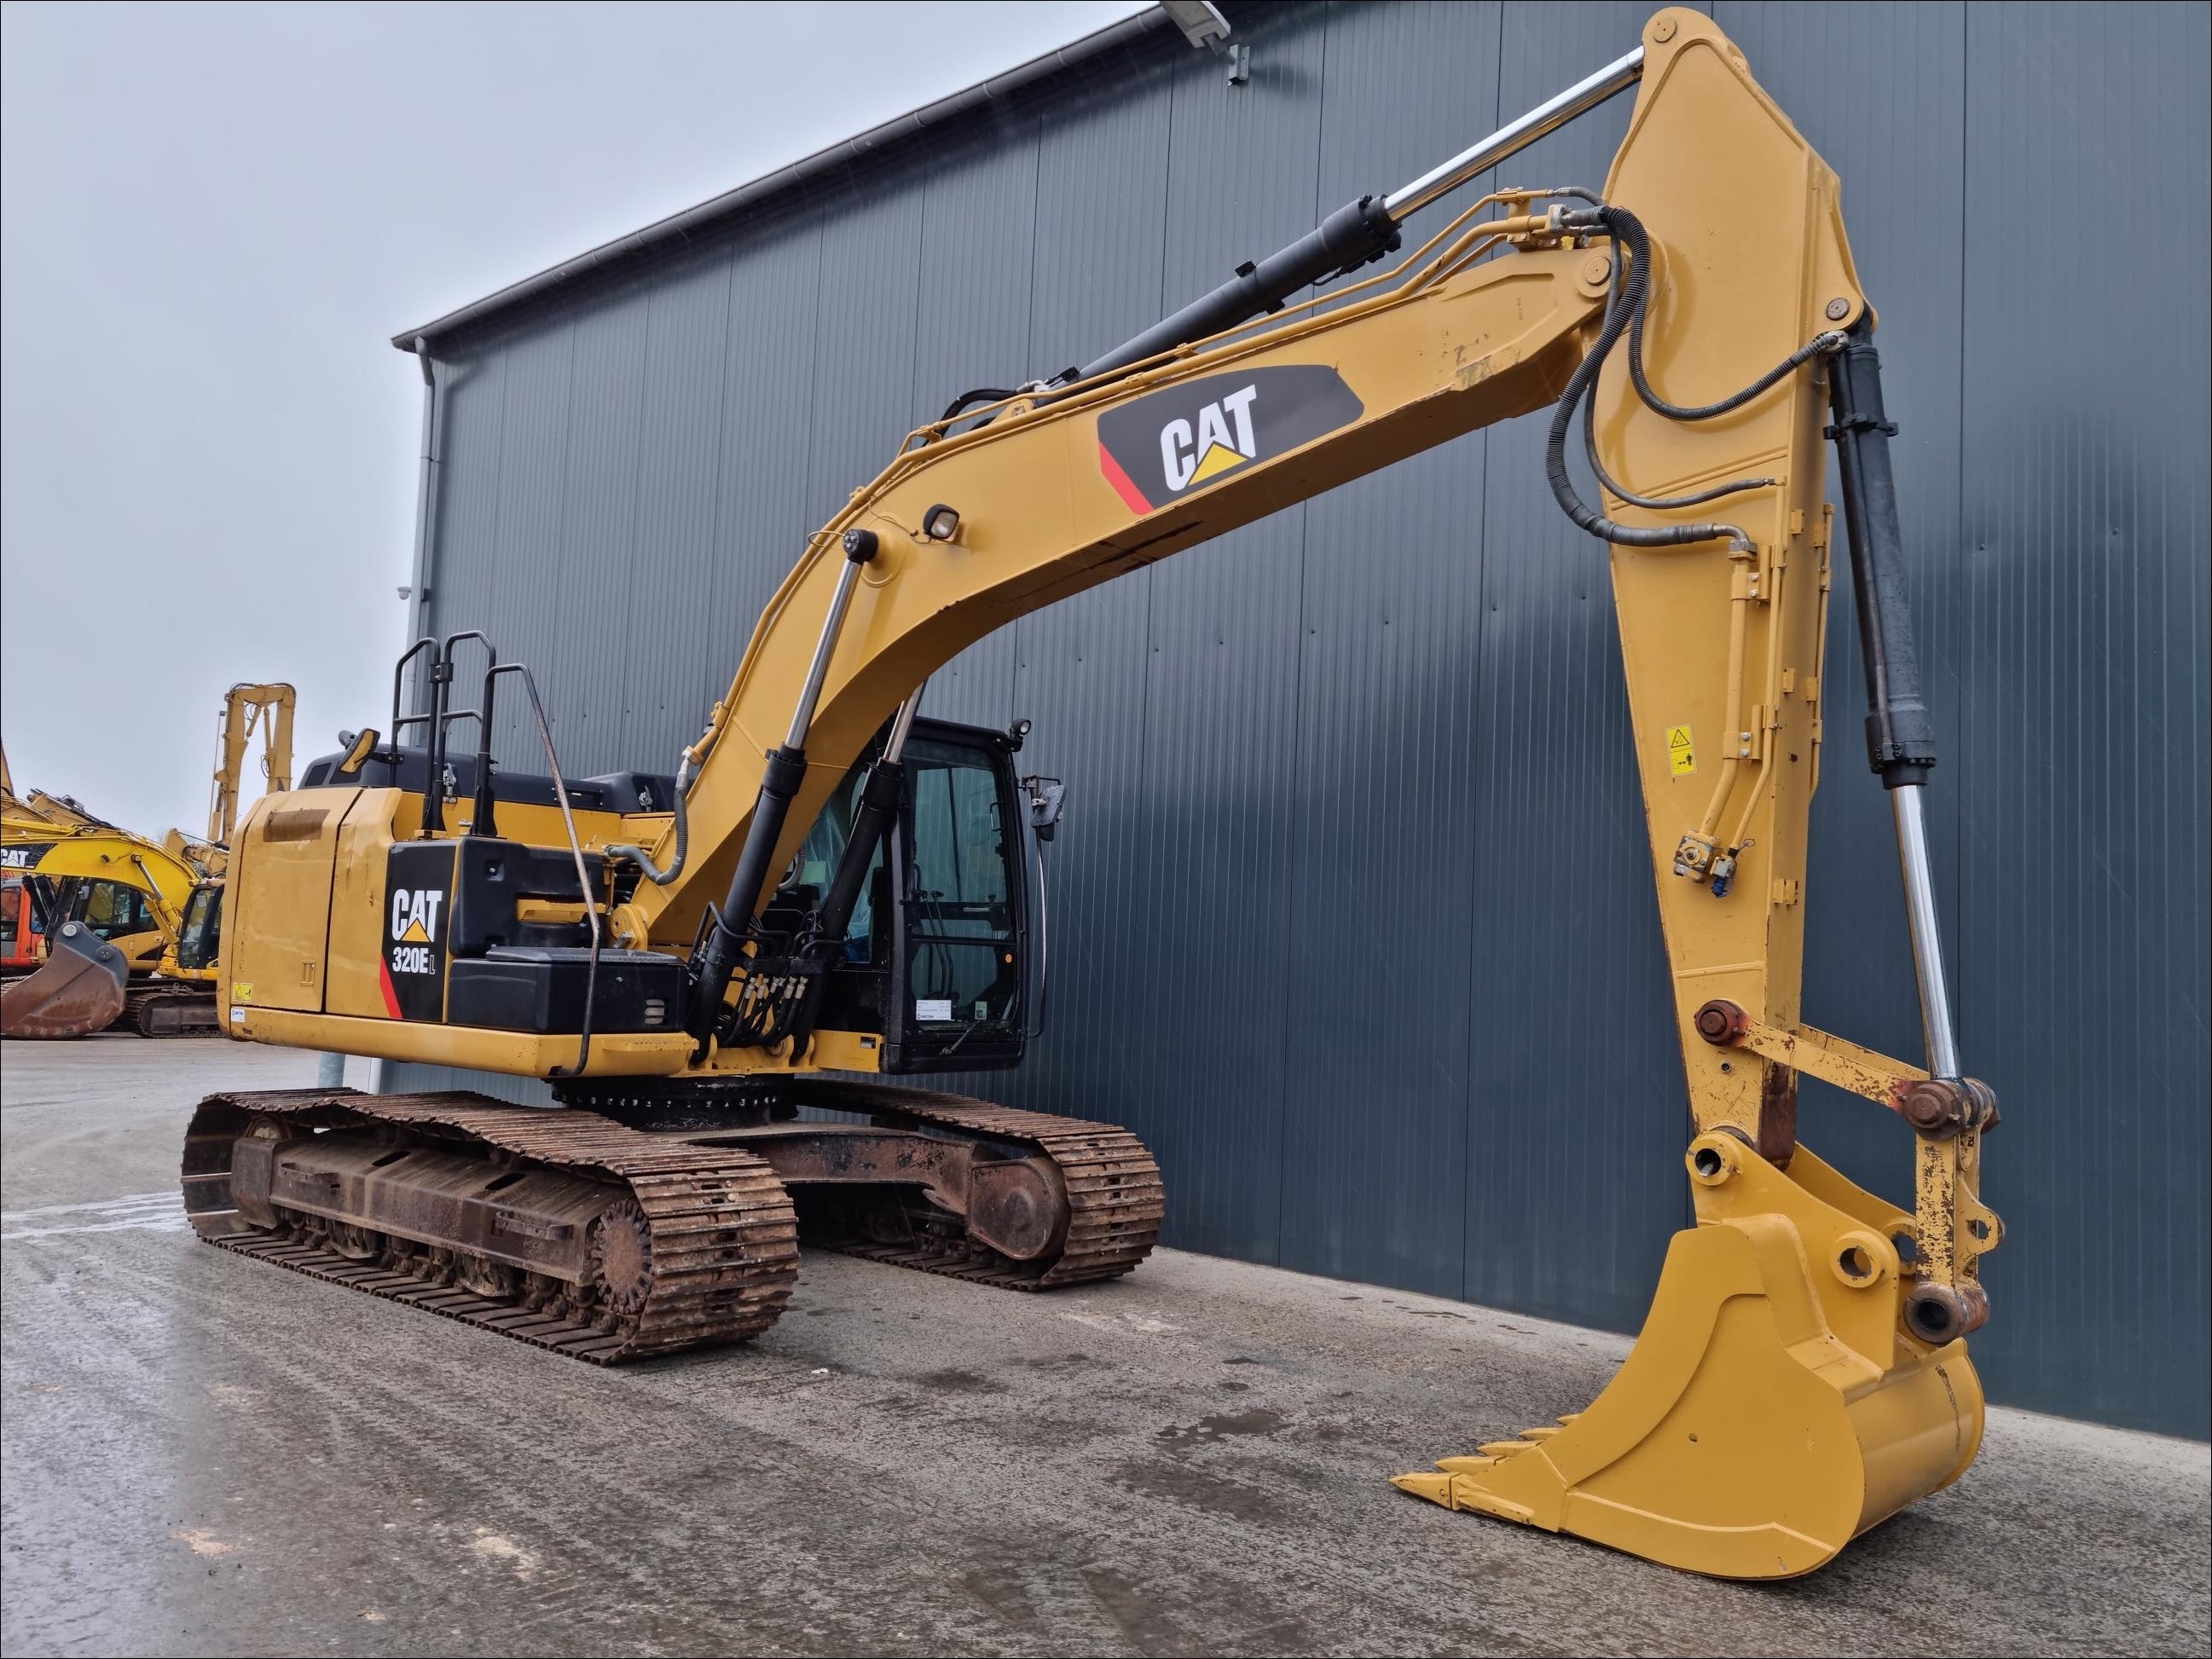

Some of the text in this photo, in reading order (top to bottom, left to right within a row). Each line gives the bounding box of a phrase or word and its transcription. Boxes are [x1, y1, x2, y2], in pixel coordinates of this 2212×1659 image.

[1161, 384, 1257, 492] CAT
[1, 848, 29, 868] CAT
[391, 888, 443, 943] CAT
